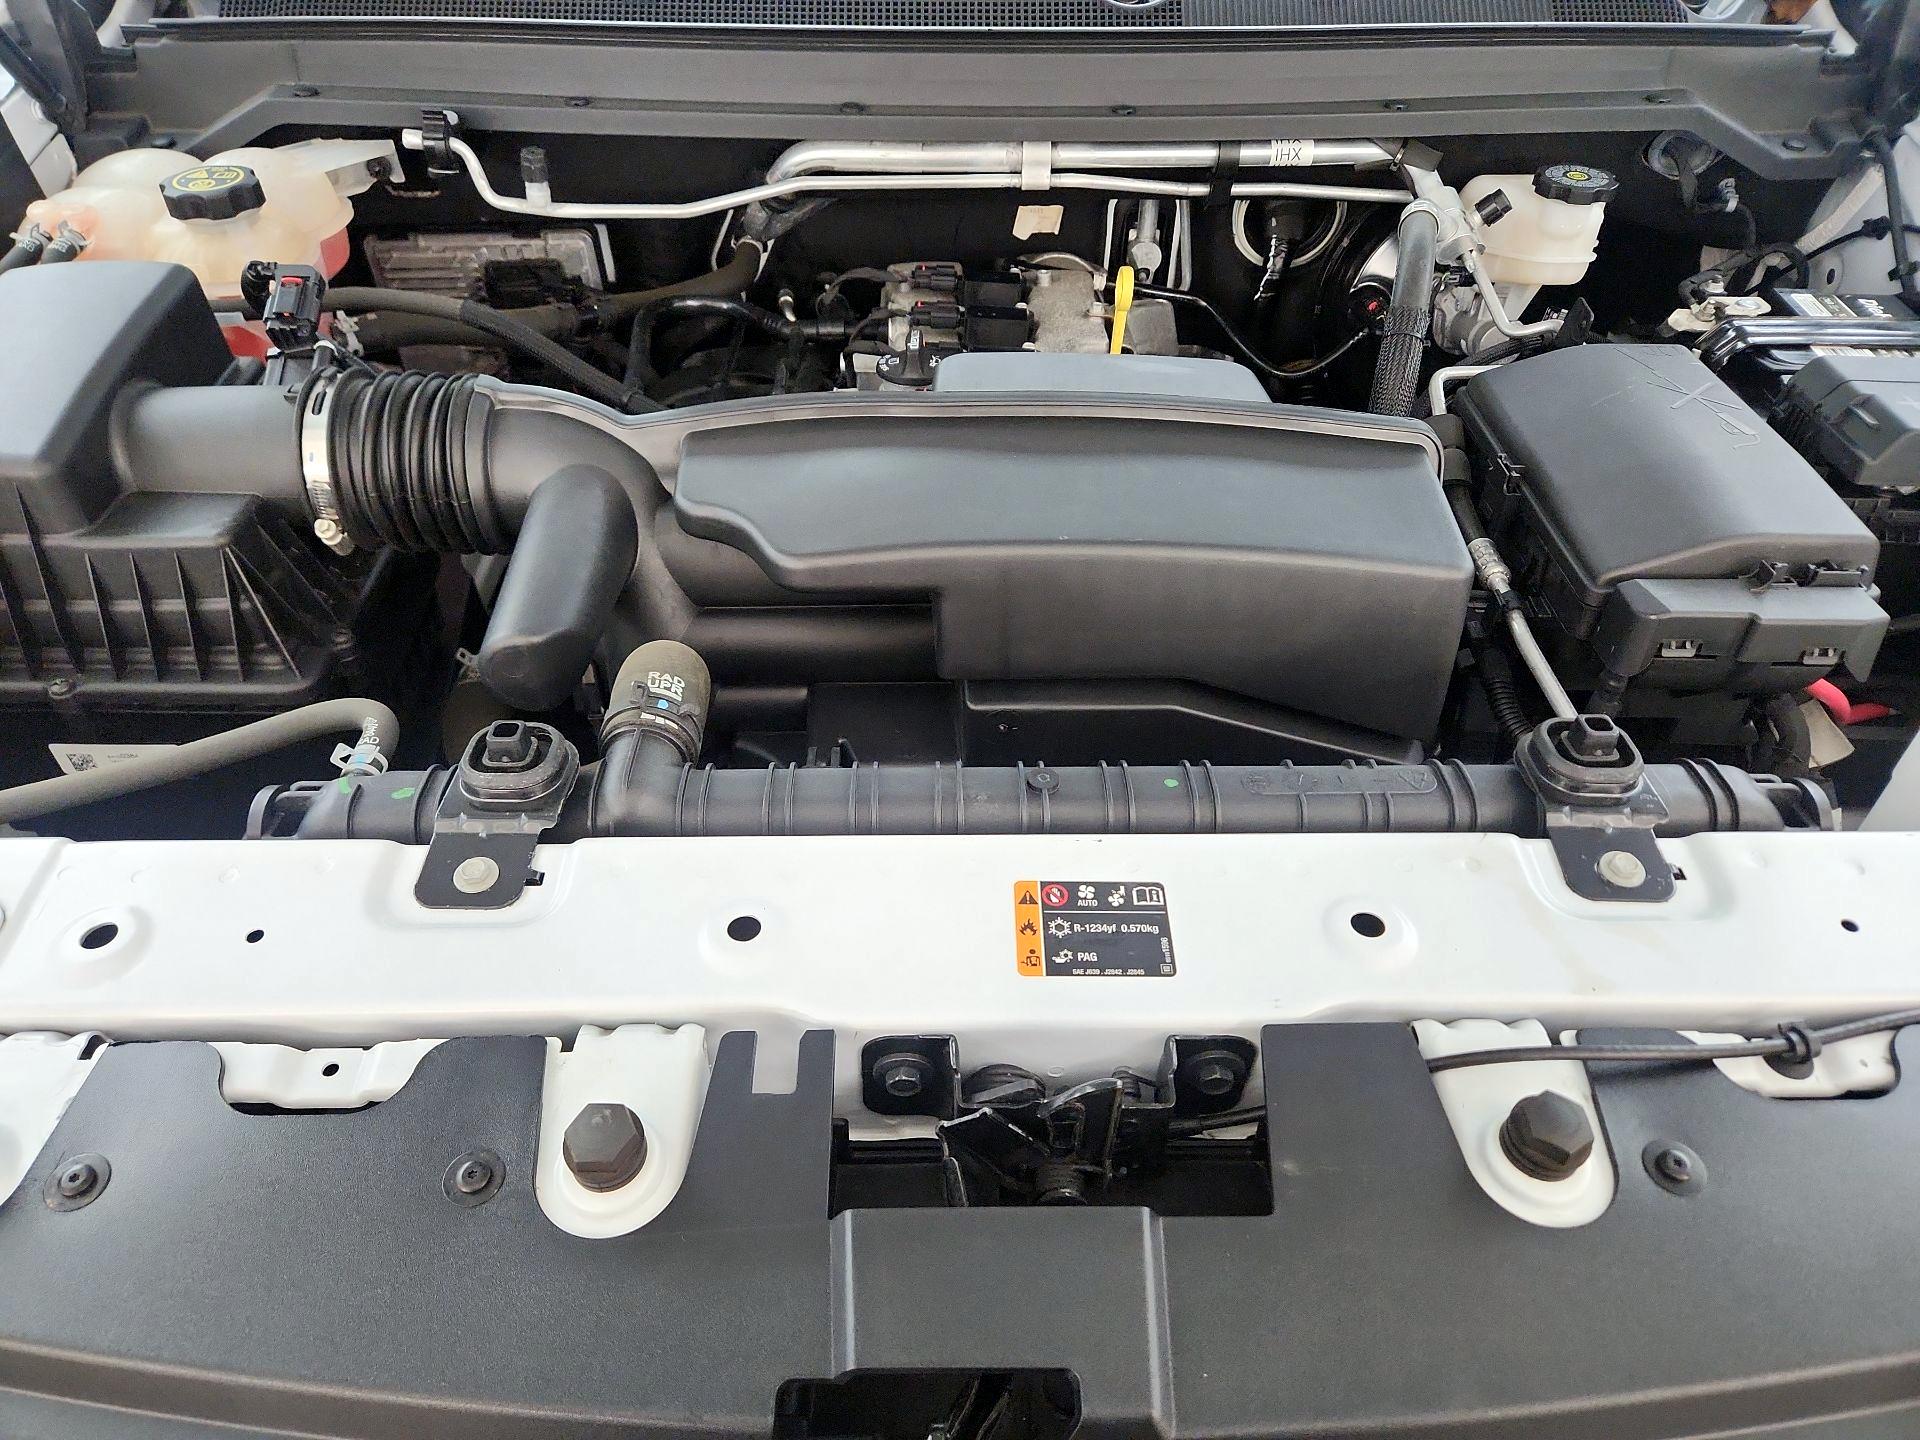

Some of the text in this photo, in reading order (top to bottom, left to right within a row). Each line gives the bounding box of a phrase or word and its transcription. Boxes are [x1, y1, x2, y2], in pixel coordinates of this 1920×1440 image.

[647, 671, 686, 688] RAD
[647, 679, 684, 697] UPR
[1077, 899, 1098, 907] AUTO
[1073, 923, 1160, 934] R-1234yf 0.570kg
[1077, 952, 1098, 962] PAG
